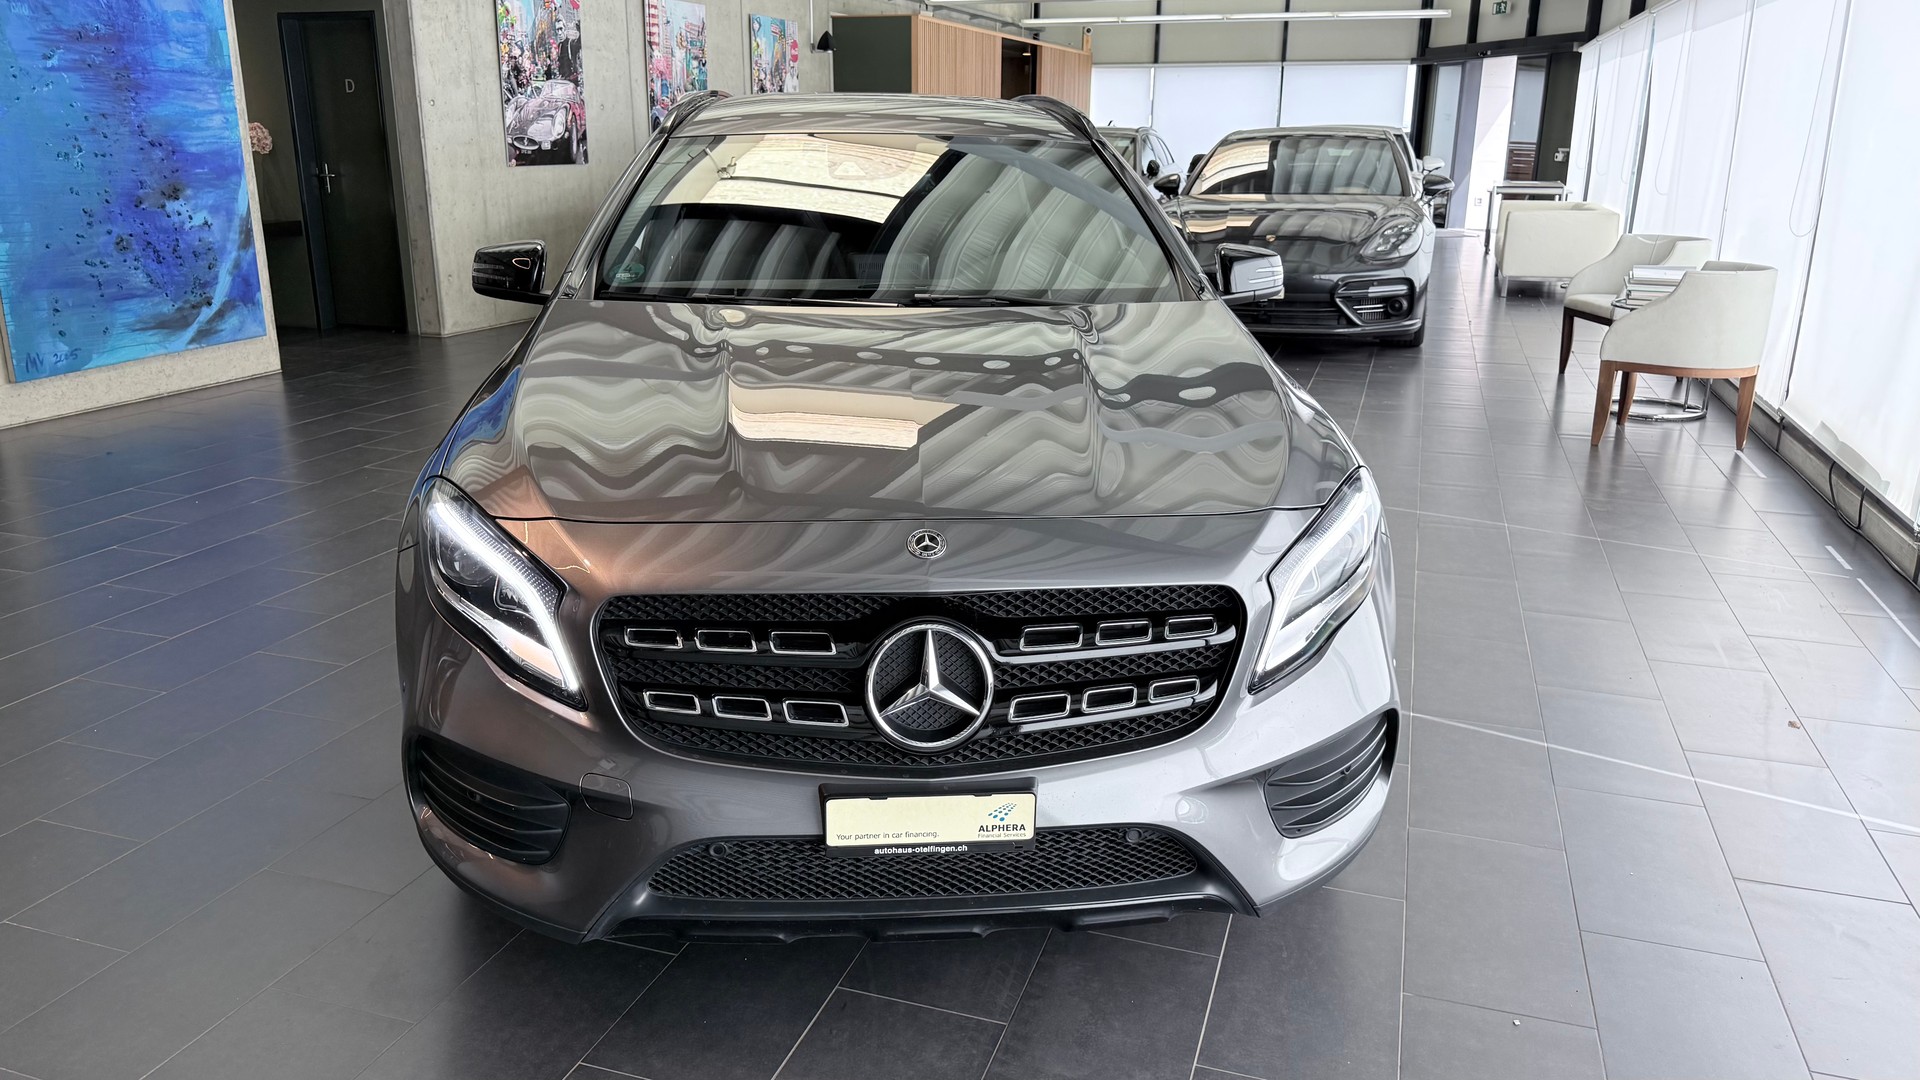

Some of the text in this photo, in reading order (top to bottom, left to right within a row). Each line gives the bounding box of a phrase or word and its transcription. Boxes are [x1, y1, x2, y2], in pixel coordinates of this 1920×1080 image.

[344, 78, 355, 93] D
[978, 823, 1026, 832] ALPHERA
[854, 833, 881, 841] partner
[904, 830, 940, 839] financing.
[874, 844, 968, 855] autohaus-otelfingen.ch
